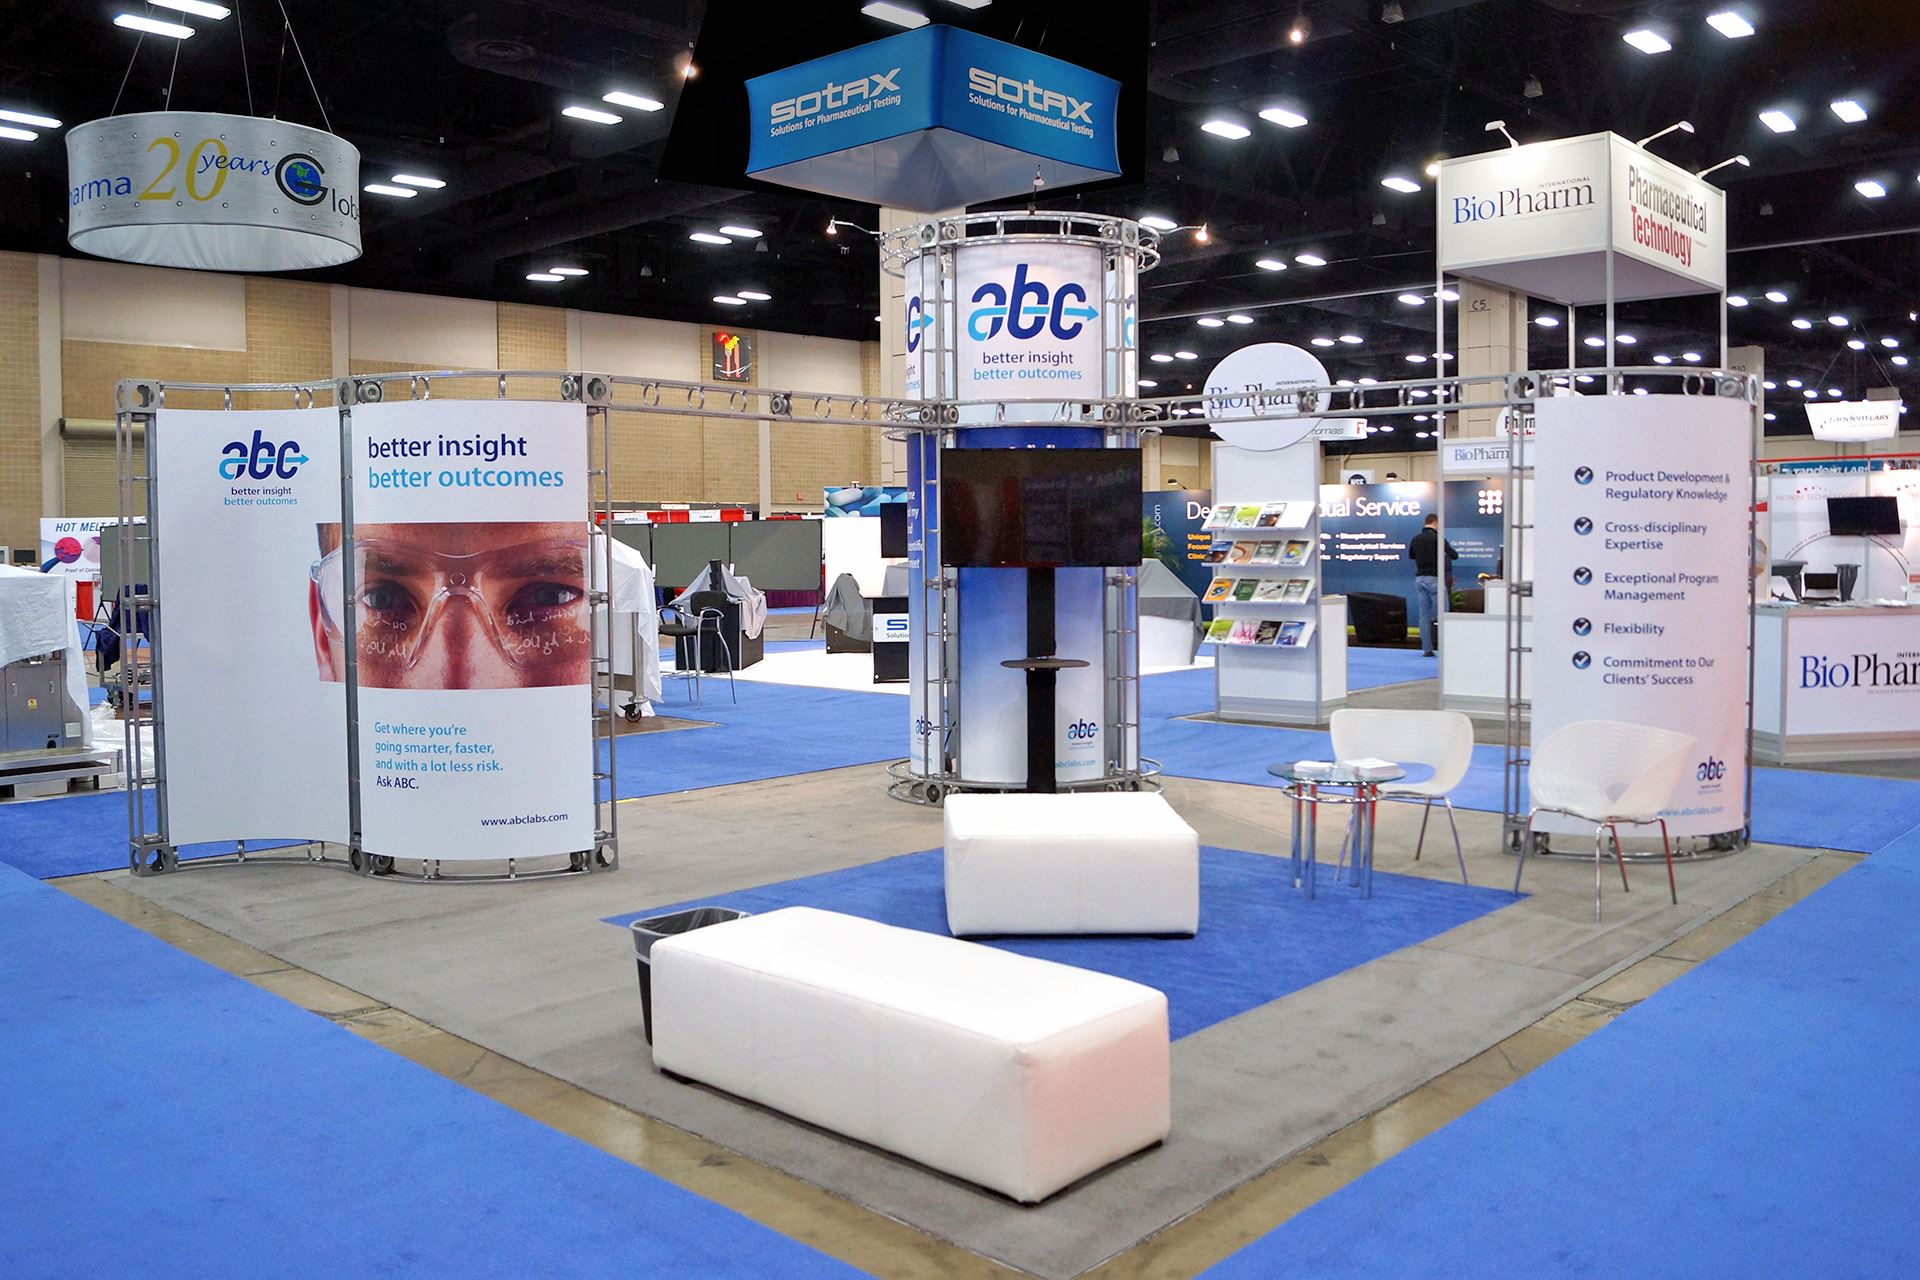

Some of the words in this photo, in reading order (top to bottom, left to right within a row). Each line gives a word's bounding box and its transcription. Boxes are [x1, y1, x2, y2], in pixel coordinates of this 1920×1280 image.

[771, 122, 803, 137] Solutions
[804, 117, 815, 128] for
[816, 99, 872, 125] Pharmaceutical
[873, 94, 901, 111] Testing
[968, 92, 1006, 113] Solutions
[1006, 103, 1018, 117] for
[1019, 107, 1070, 131] Pharmaceutical
[1071, 122, 1094, 139] Testing
[198, 151, 275, 177] years
[69, 175, 132, 208] arma
[138, 136, 229, 202] 20
[1537, 176, 1591, 189] INTERNATIONAL
[1453, 183, 1595, 225] BioPharm
[1628, 163, 1707, 234] Pharmaceutical
[1631, 203, 1692, 268] Technology
[968, 263, 1087, 341] abc
[982, 351, 1024, 365] better
[1028, 350, 1074, 367] insight
[973, 367, 1014, 381] better
[1018, 367, 1083, 380] outcomes
[1275, 378, 1317, 386] INTERNATIONAL
[219, 429, 301, 481] abc
[367, 436, 432, 459] better
[437, 433, 528, 463] insight
[368, 466, 433, 489] better
[437, 467, 565, 488] outcomes
[1605, 470, 1655, 482] Product
[1656, 471, 1724, 485] Development
[1724, 473, 1730, 484] &
[231, 486, 260, 496] better
[262, 486, 292, 497] insight
[1605, 488, 1674, 502] Regulatory
[1675, 488, 1729, 503] Knowledge
[224, 497, 253, 506] better
[255, 497, 298, 506] outcomes
[1355, 496, 1421, 517] Service
[55, 522, 77, 532] HOT
[1605, 522, 1708, 536] Cross-disciplinary
[1605, 538, 1664, 552] Expertise
[1374, 553, 1400, 561] Support
[1604, 572, 1677, 586] Exceptional
[1677, 572, 1719, 586] Program
[1604, 589, 1685, 603] Management
[1604, 622, 1665, 637] Flexibility
[1603, 656, 1683, 668] Commitment
[1686, 656, 1696, 668] to
[1697, 656, 1715, 668] Our
[1651, 674, 1694, 685] Success
[374, 721, 390, 734] Get
[392, 723, 426, 736] where
[1067, 718, 1096, 740] abc
[375, 741, 402, 756] going
[404, 744, 453, 756] smarter,
[454, 741, 495, 755] faster,
[375, 758, 393, 770] and
[394, 760, 418, 772] with
[420, 763, 428, 772] a
[430, 760, 447, 772] lot
[449, 759, 474, 772] less
[476, 759, 504, 772] risk.
[1696, 755, 1725, 782] abc
[376, 775, 393, 788] Ask
[394, 777, 420, 790] ABC.
[480, 812, 569, 827] www.abclabs.com
